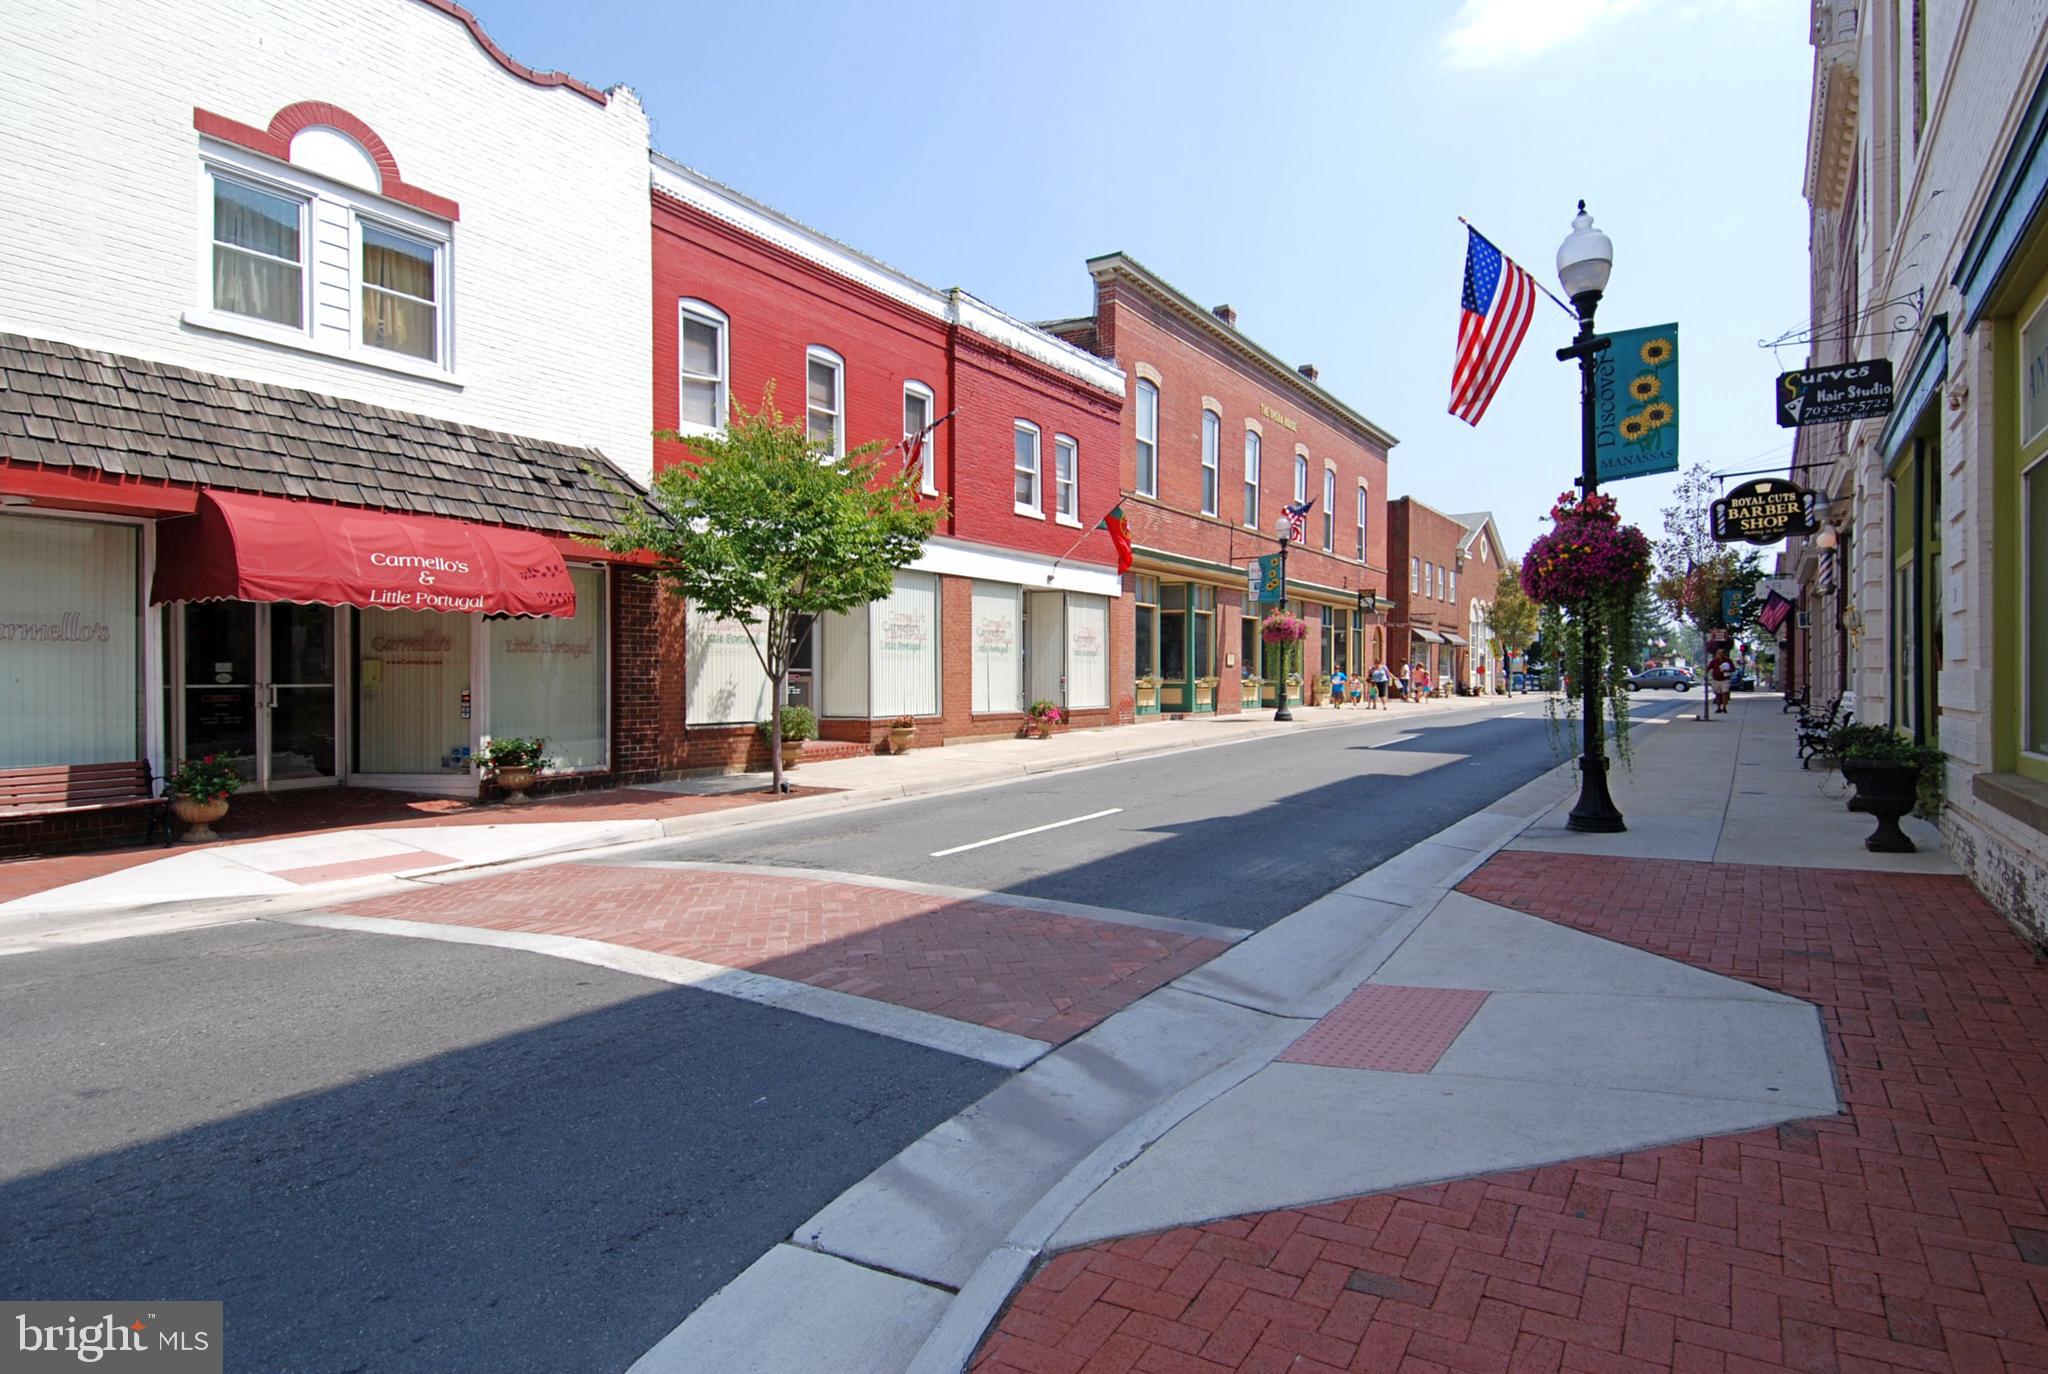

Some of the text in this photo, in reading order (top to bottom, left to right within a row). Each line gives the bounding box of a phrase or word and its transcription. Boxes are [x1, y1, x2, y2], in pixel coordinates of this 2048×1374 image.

[1597, 349, 1615, 447] Discover
[1817, 382, 1891, 403] Hair Studio
[1804, 399, 1889, 418] 703-257-5722
[1601, 449, 1674, 469] MANASSAS
[1731, 492, 1796, 508] ROYAL CUTS
[1728, 502, 1801, 520] BARBER
[1740, 515, 1788, 530] SHOP
[370, 552, 469, 574] Carmello's
[418, 570, 435, 586] &
[369, 589, 484, 610] Little Portugal
